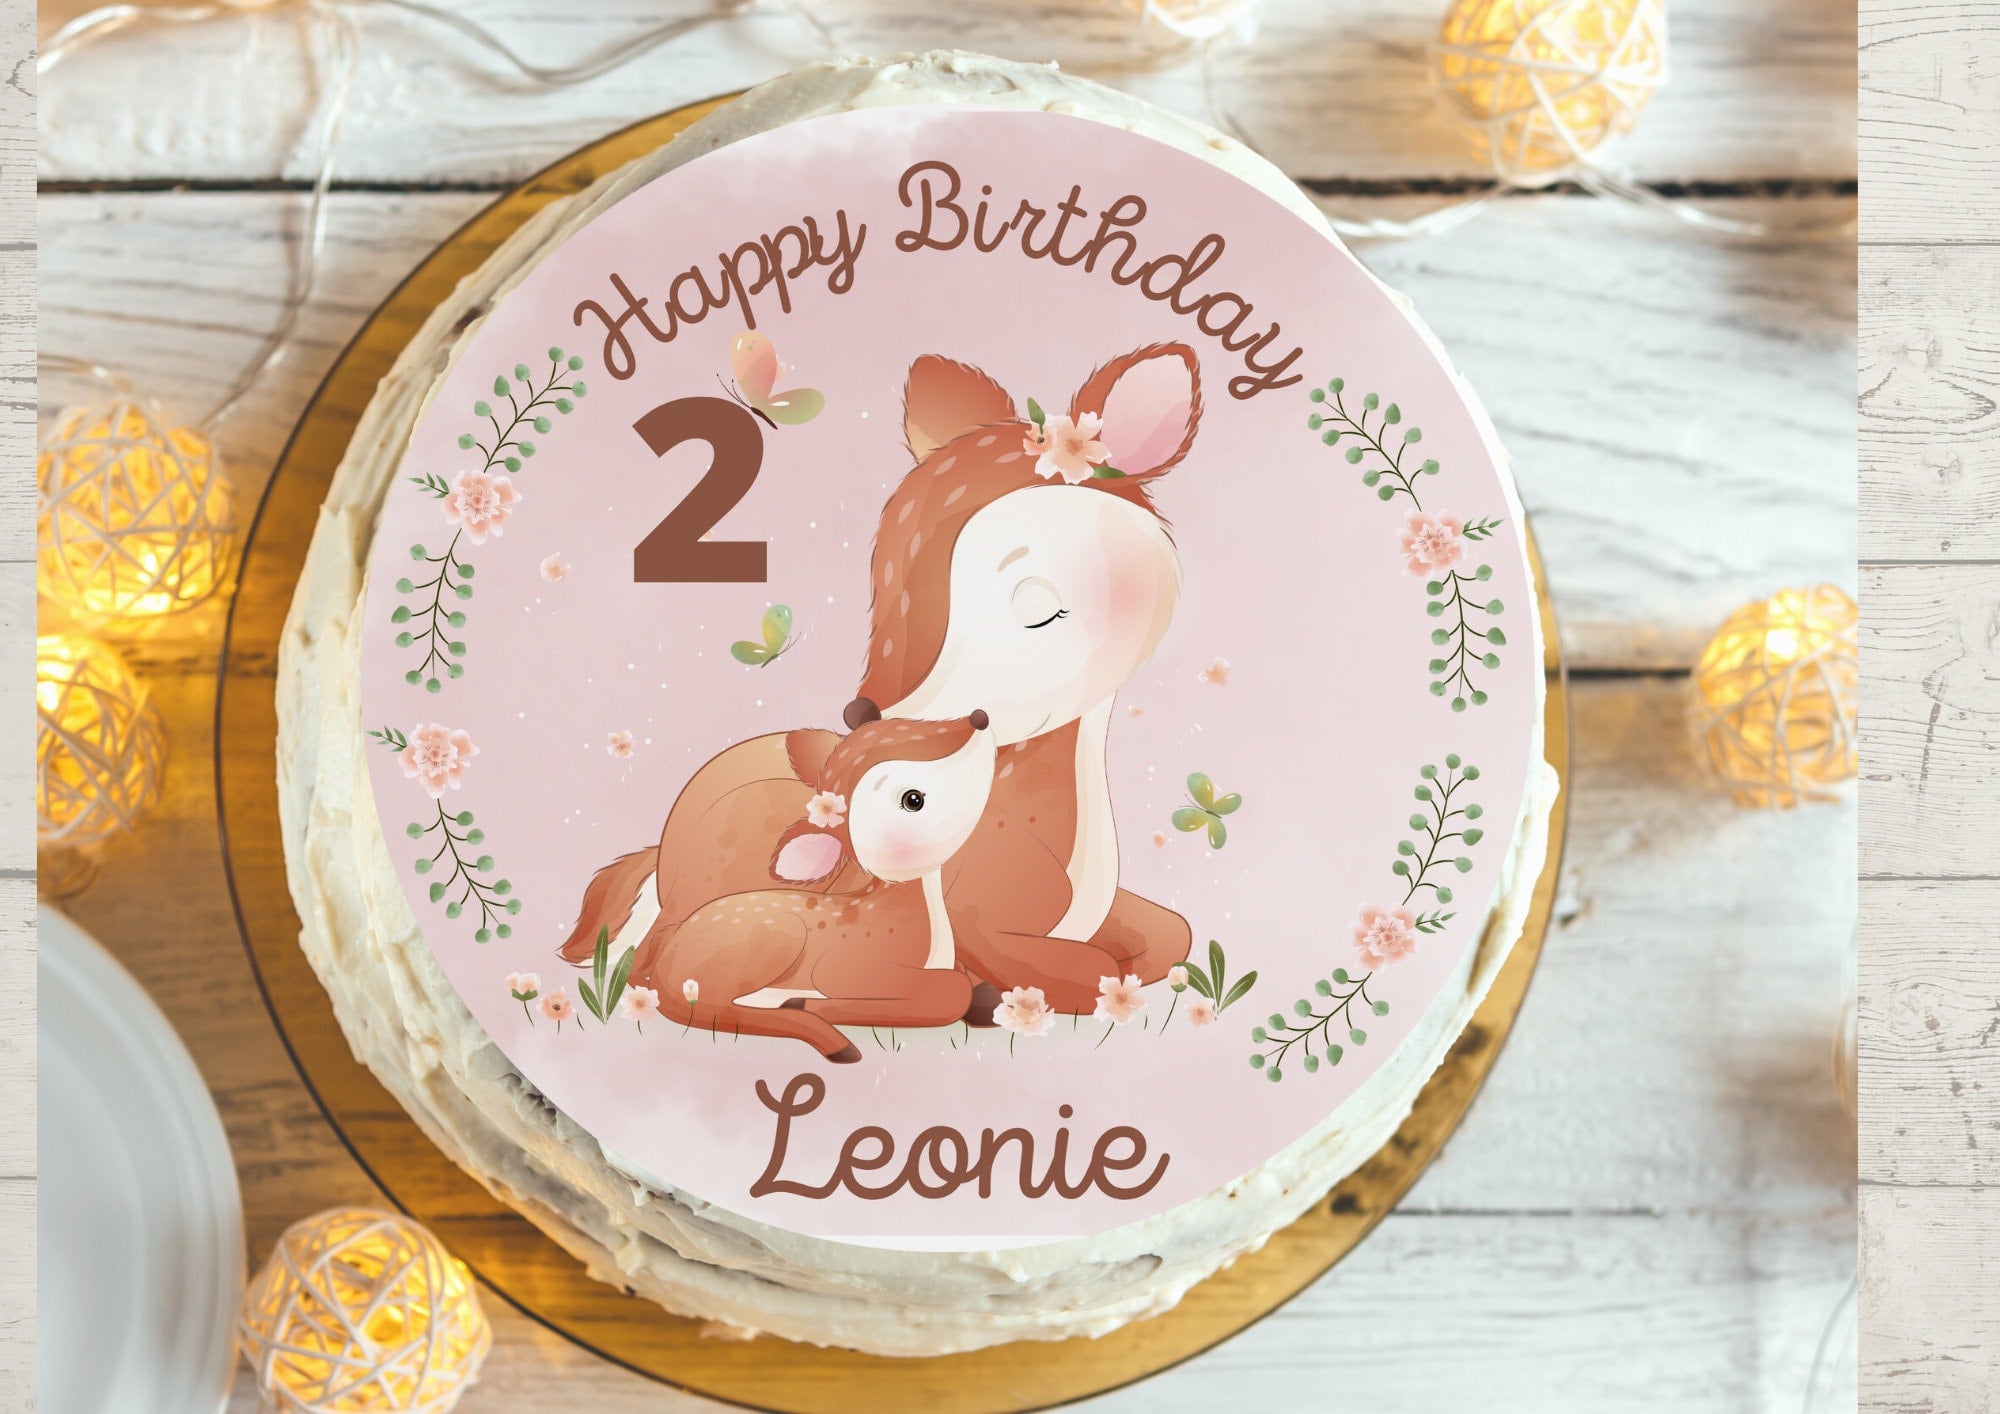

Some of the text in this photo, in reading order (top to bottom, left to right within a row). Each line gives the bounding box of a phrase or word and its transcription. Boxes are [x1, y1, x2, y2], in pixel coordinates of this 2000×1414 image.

[574, 161, 1303, 400] Happy Birthday
[633, 396, 768, 583] 2
[750, 1073, 1170, 1199] Leonie
